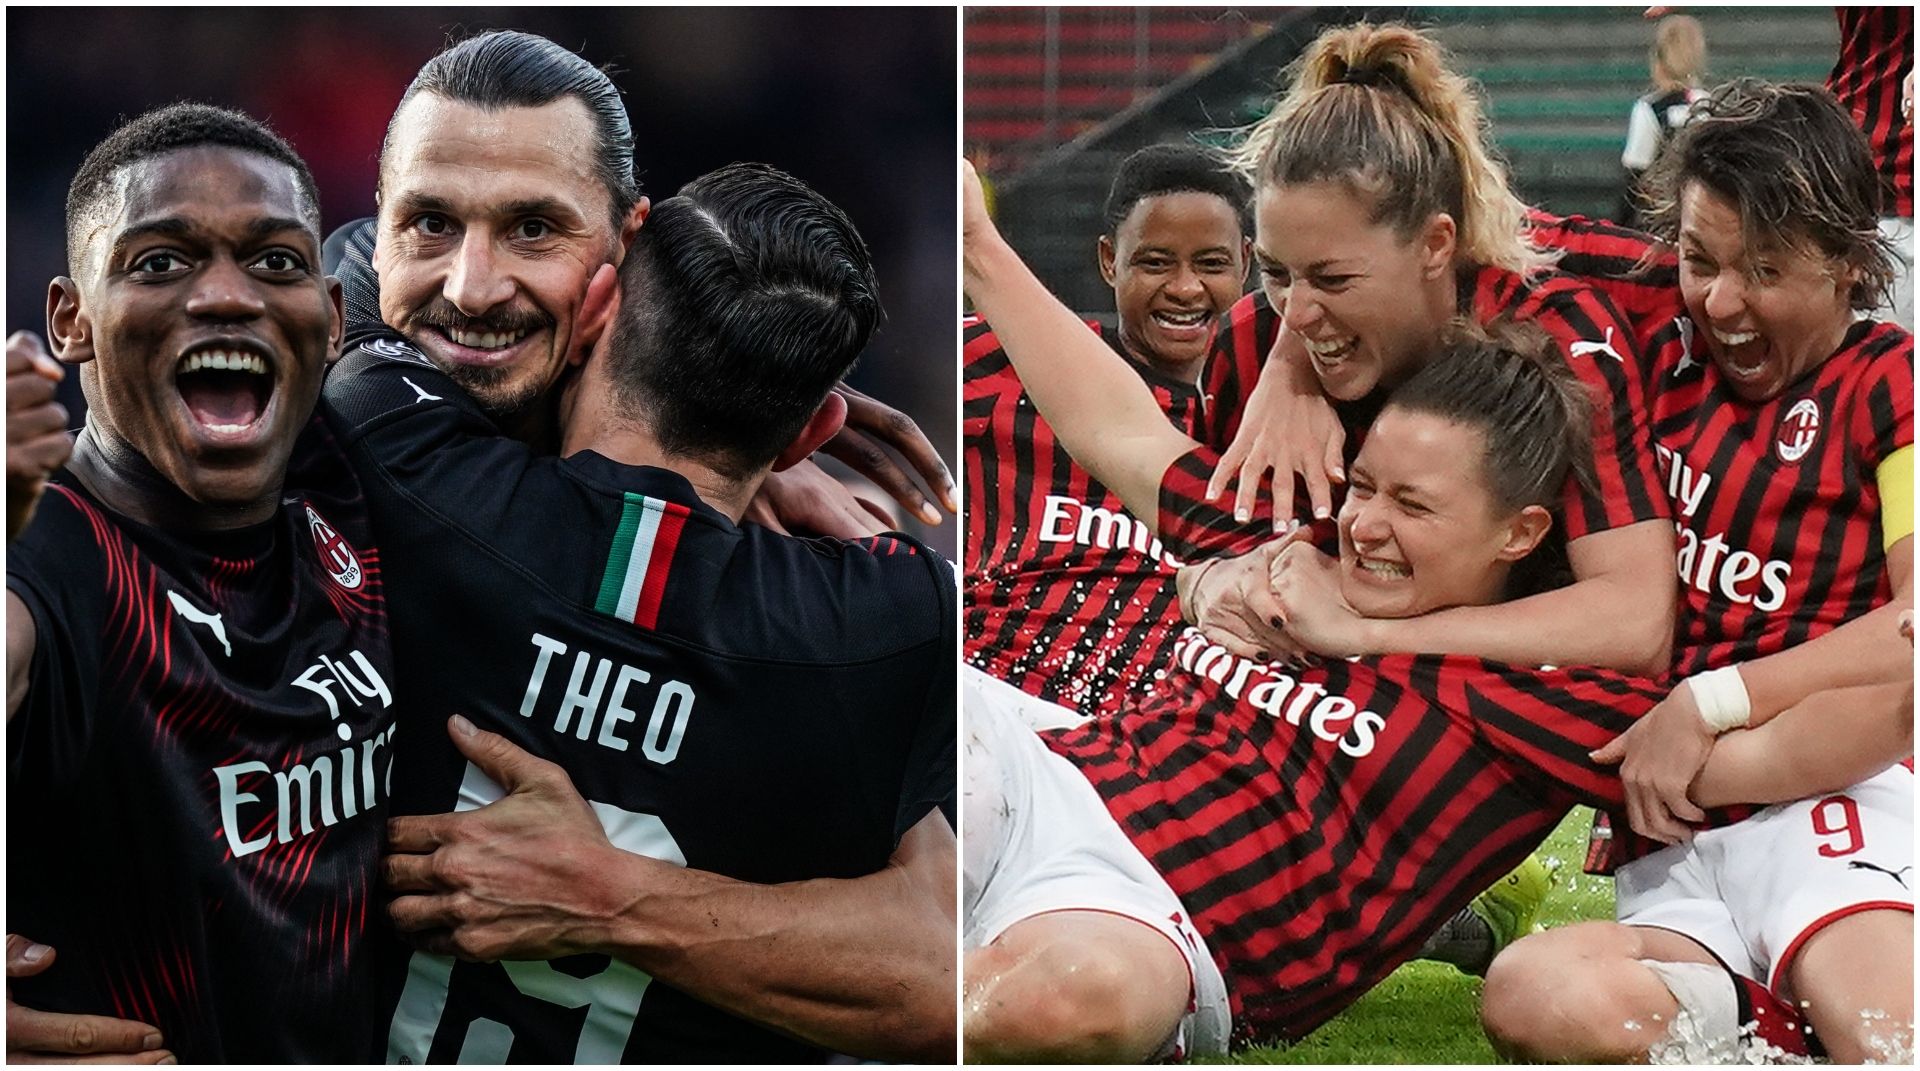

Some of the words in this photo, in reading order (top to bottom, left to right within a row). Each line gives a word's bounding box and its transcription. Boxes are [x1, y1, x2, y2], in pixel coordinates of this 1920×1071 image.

[339, 566, 359, 585] 1899
[1676, 521, 1792, 612] ates
[290, 649, 393, 720] Fly
[519, 632, 696, 765] THEO
[212, 722, 397, 858] Emir
[1810, 794, 1865, 858] 9
